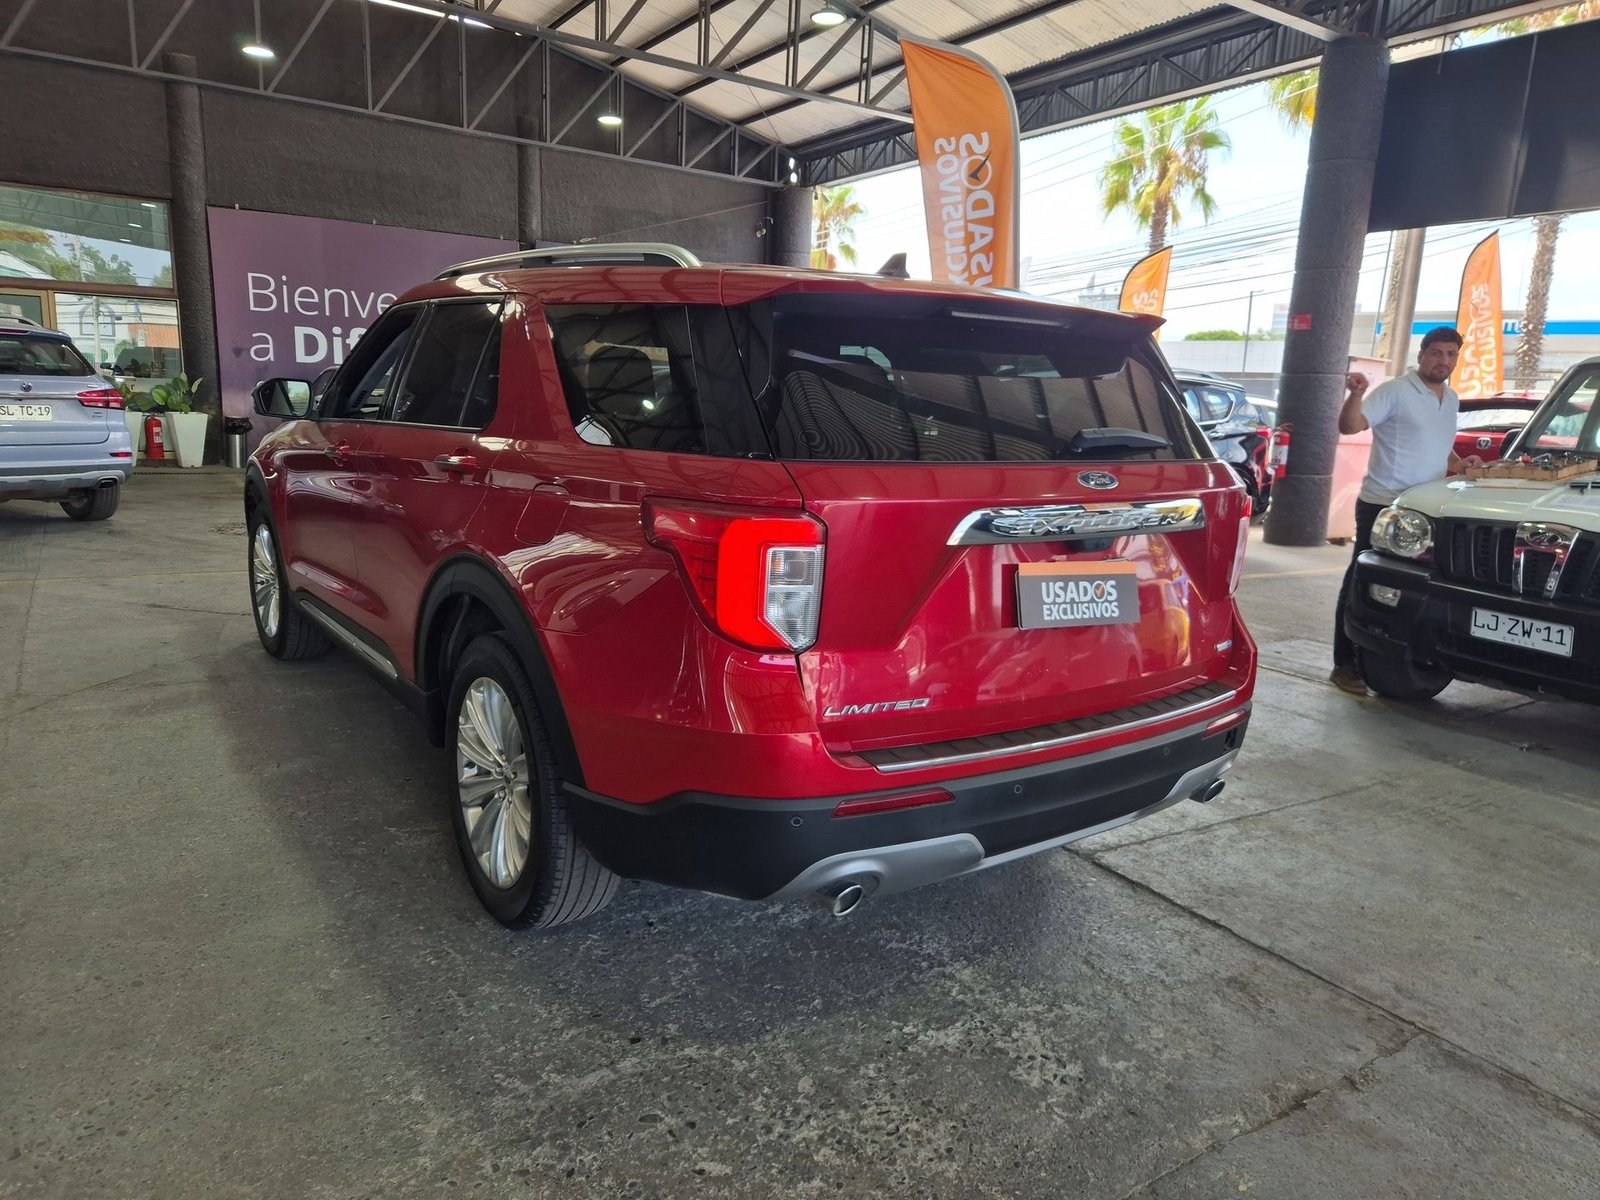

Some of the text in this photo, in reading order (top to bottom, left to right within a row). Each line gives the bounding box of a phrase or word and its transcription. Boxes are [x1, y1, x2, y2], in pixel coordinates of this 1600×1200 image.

[249, 332, 275, 361] a
[1088, 472, 1111, 485] Ford
[1041, 580, 1118, 604] USADOS
[1043, 602, 1120, 621] EXCLUSIVOS
[823, 698, 930, 717] LIMITED
